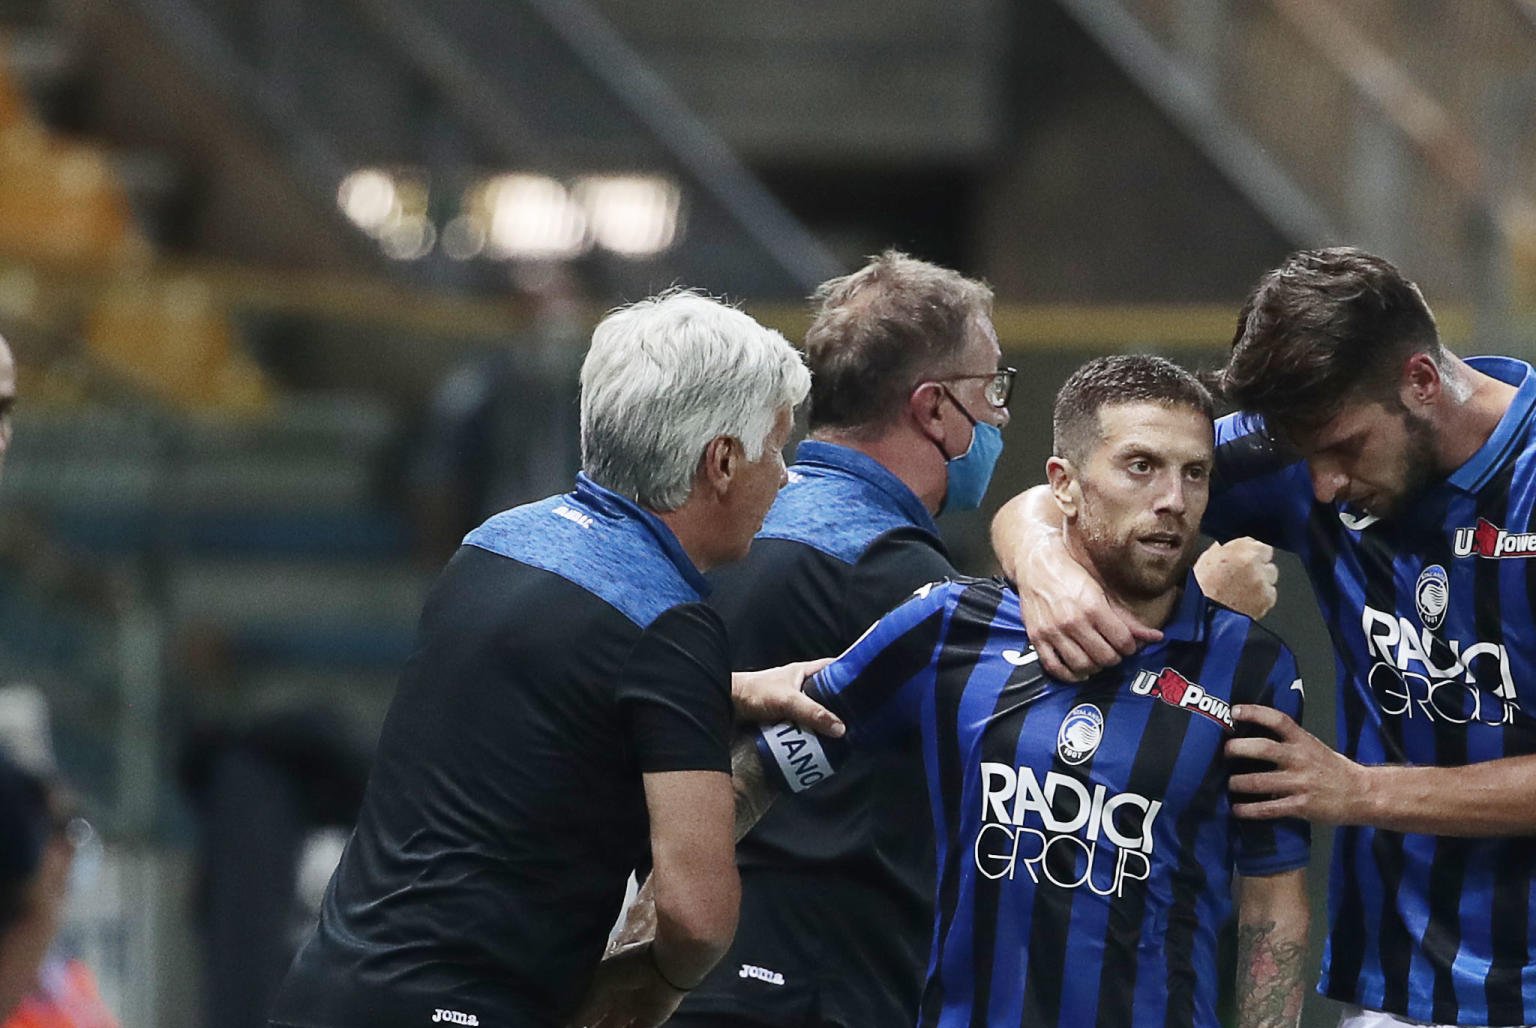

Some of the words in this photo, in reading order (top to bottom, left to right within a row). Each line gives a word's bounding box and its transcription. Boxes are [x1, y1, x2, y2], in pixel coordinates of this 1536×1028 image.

[1454, 529, 1475, 556] U
[1132, 671, 1158, 695] U
[980, 762, 1162, 854] RADICI
[974, 823, 1150, 898] GROUP
[432, 1008, 479, 1027] Joma
